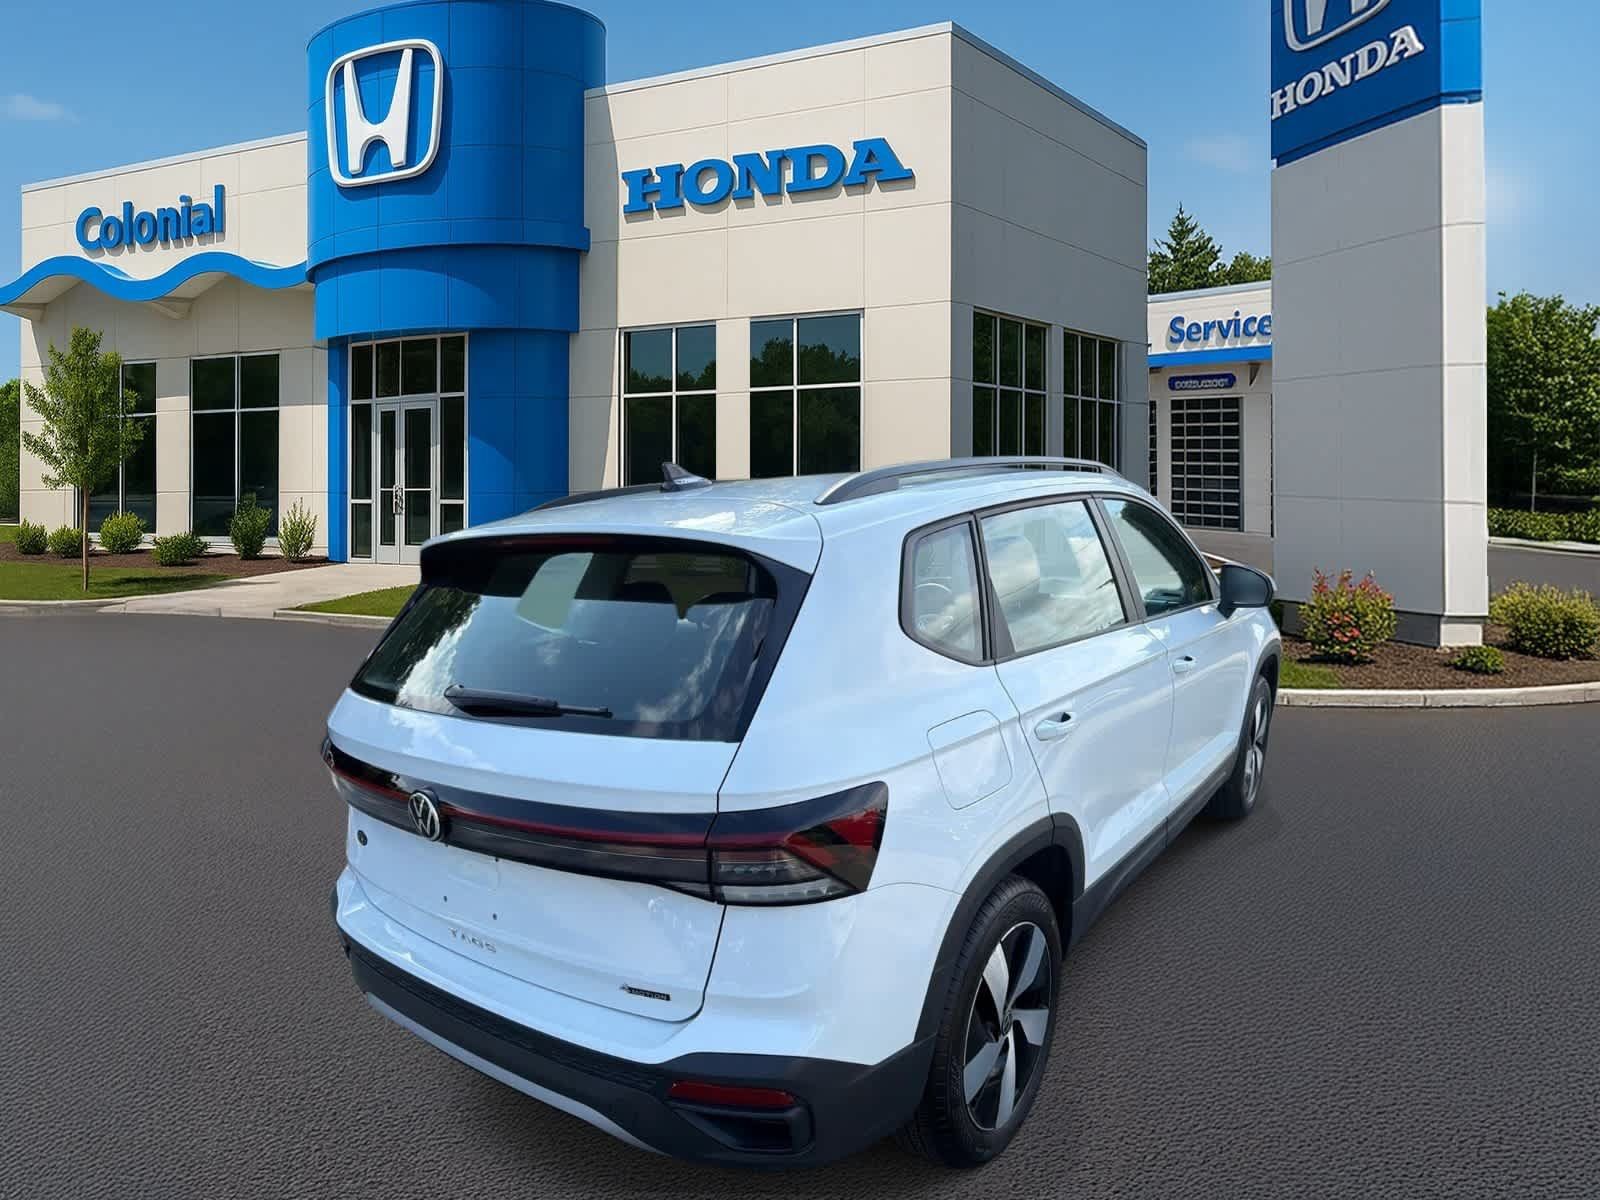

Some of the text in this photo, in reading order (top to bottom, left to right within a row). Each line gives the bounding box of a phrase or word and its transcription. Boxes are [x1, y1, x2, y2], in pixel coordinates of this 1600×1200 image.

[1272, 24, 1425, 121] HONDA
[621, 136, 914, 214] HONDA
[75, 183, 226, 252] Colonial
[1169, 310, 1272, 344] Service
